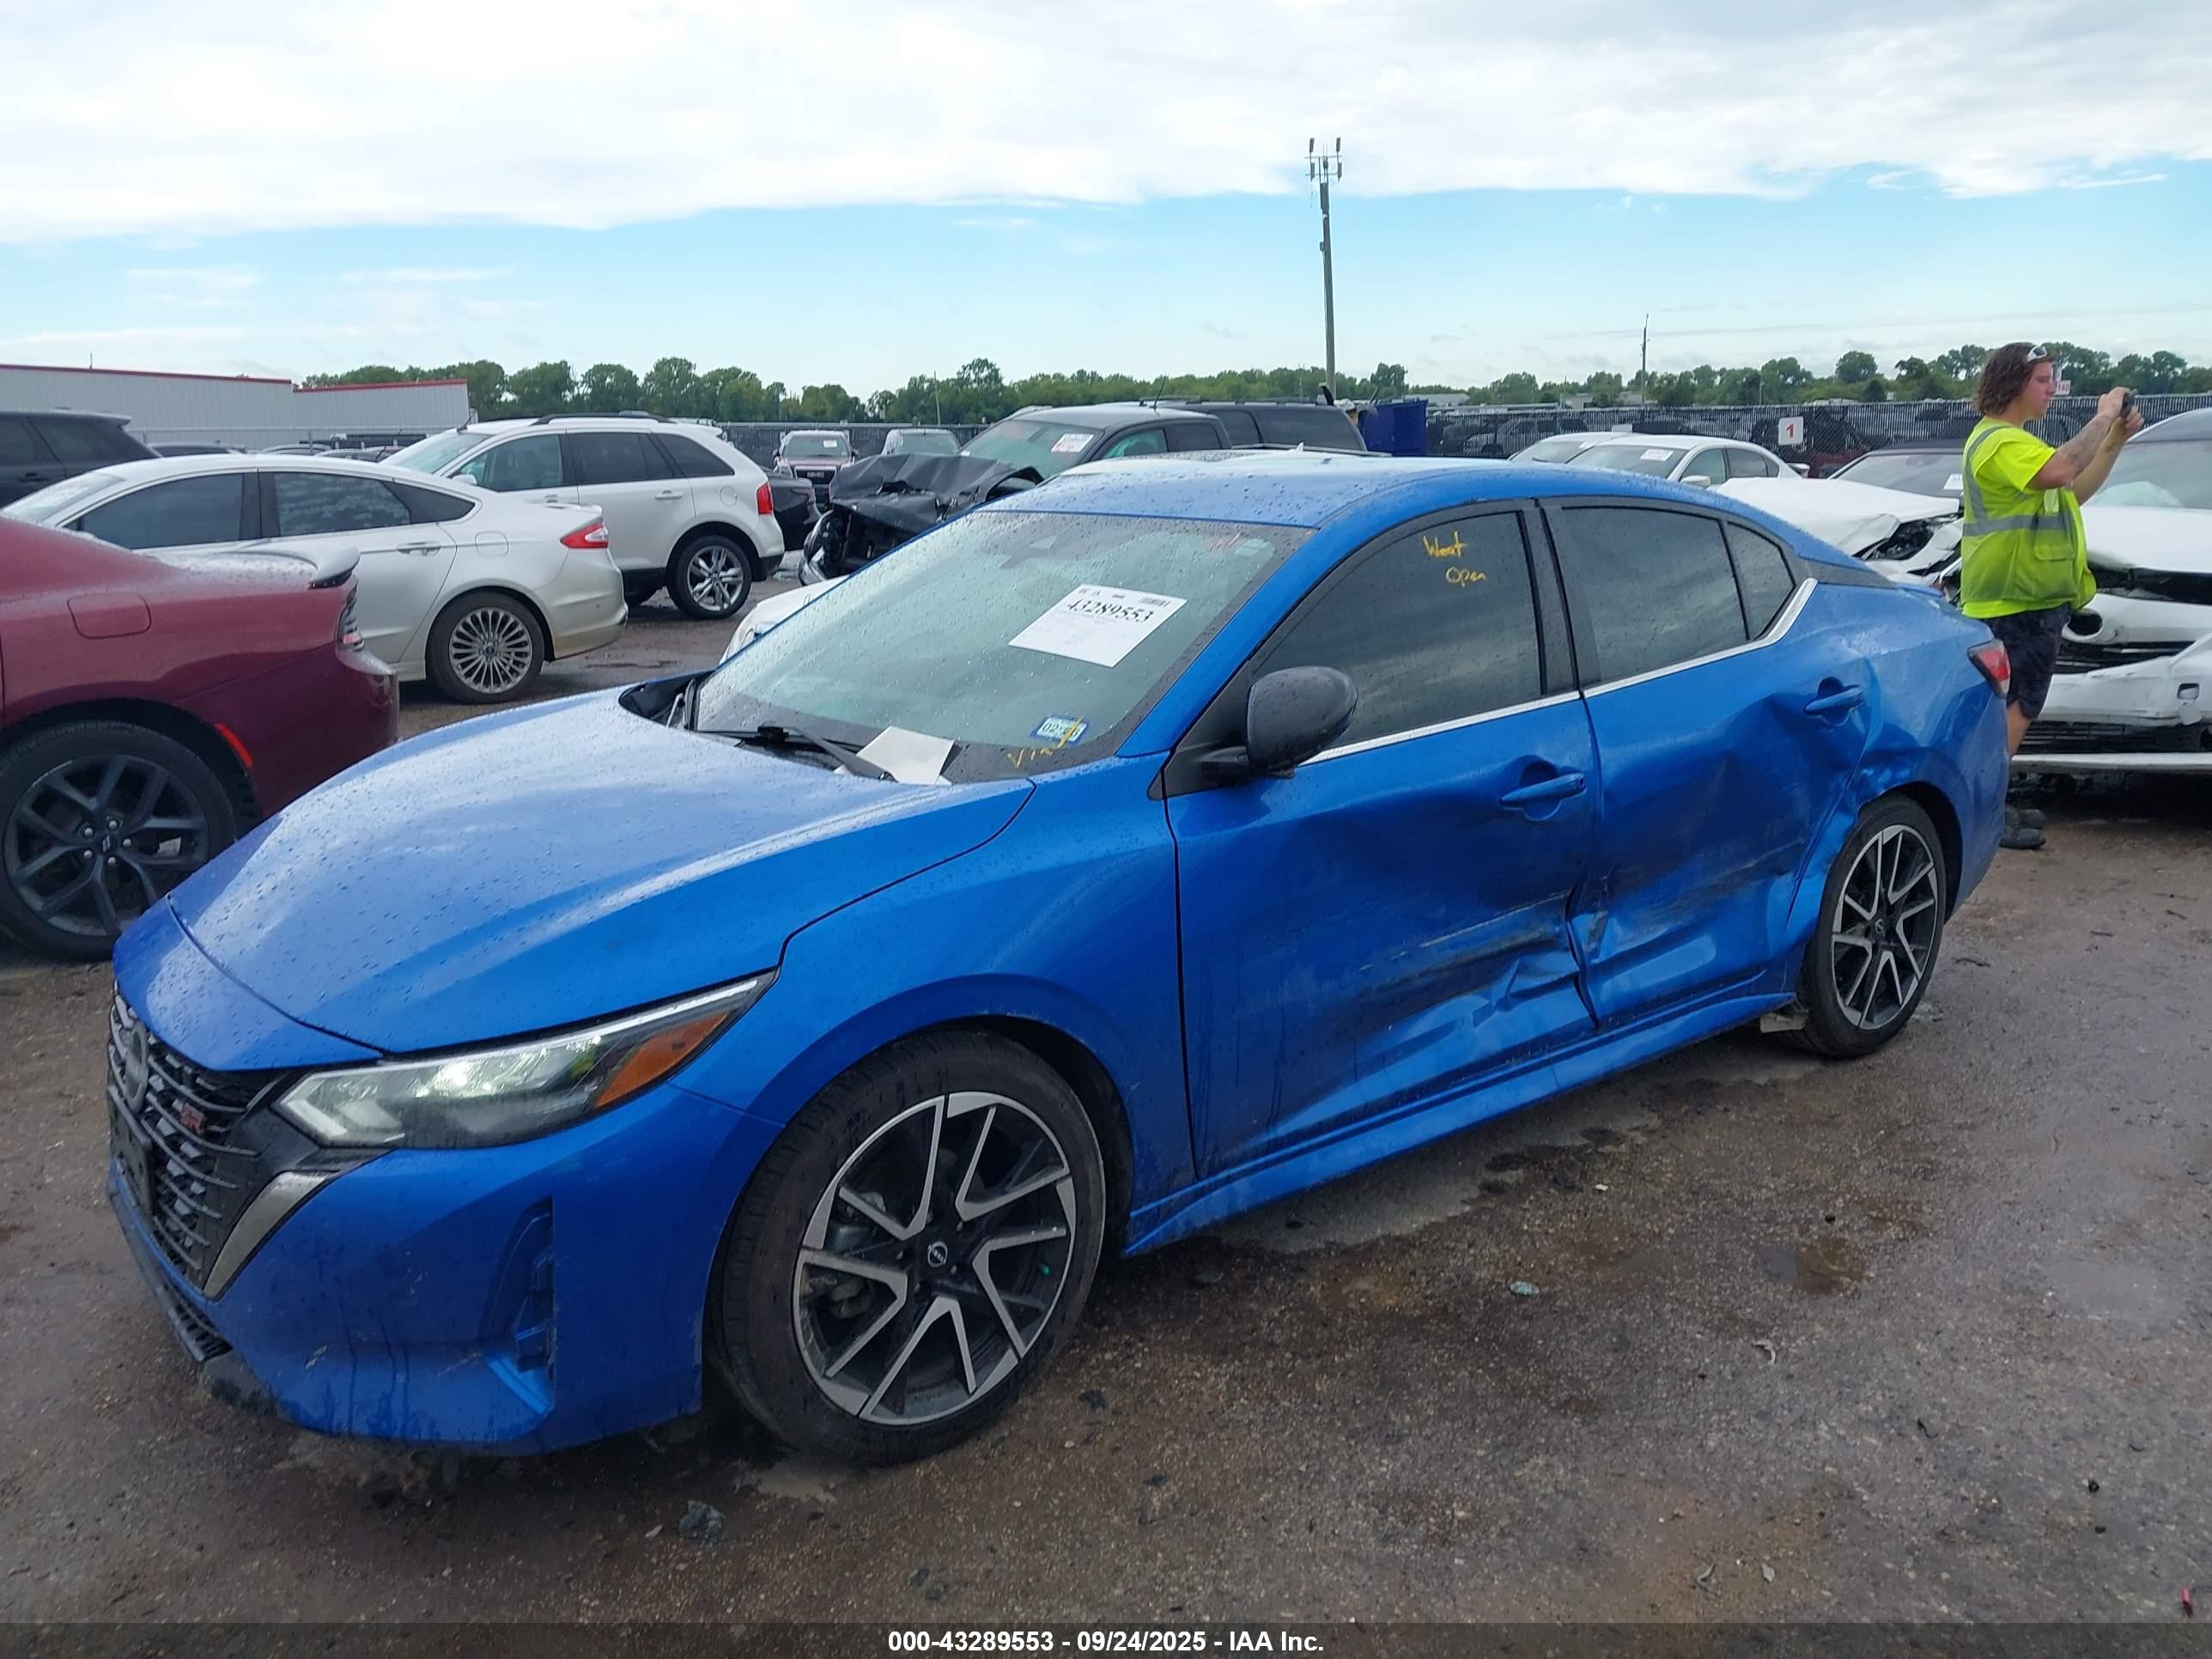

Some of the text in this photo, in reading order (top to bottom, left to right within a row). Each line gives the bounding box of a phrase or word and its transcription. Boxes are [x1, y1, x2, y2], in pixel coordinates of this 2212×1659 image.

[1786, 423, 1795, 438] 1
[1445, 566, 1486, 587] Open
[1066, 599, 1155, 623] 43289553
